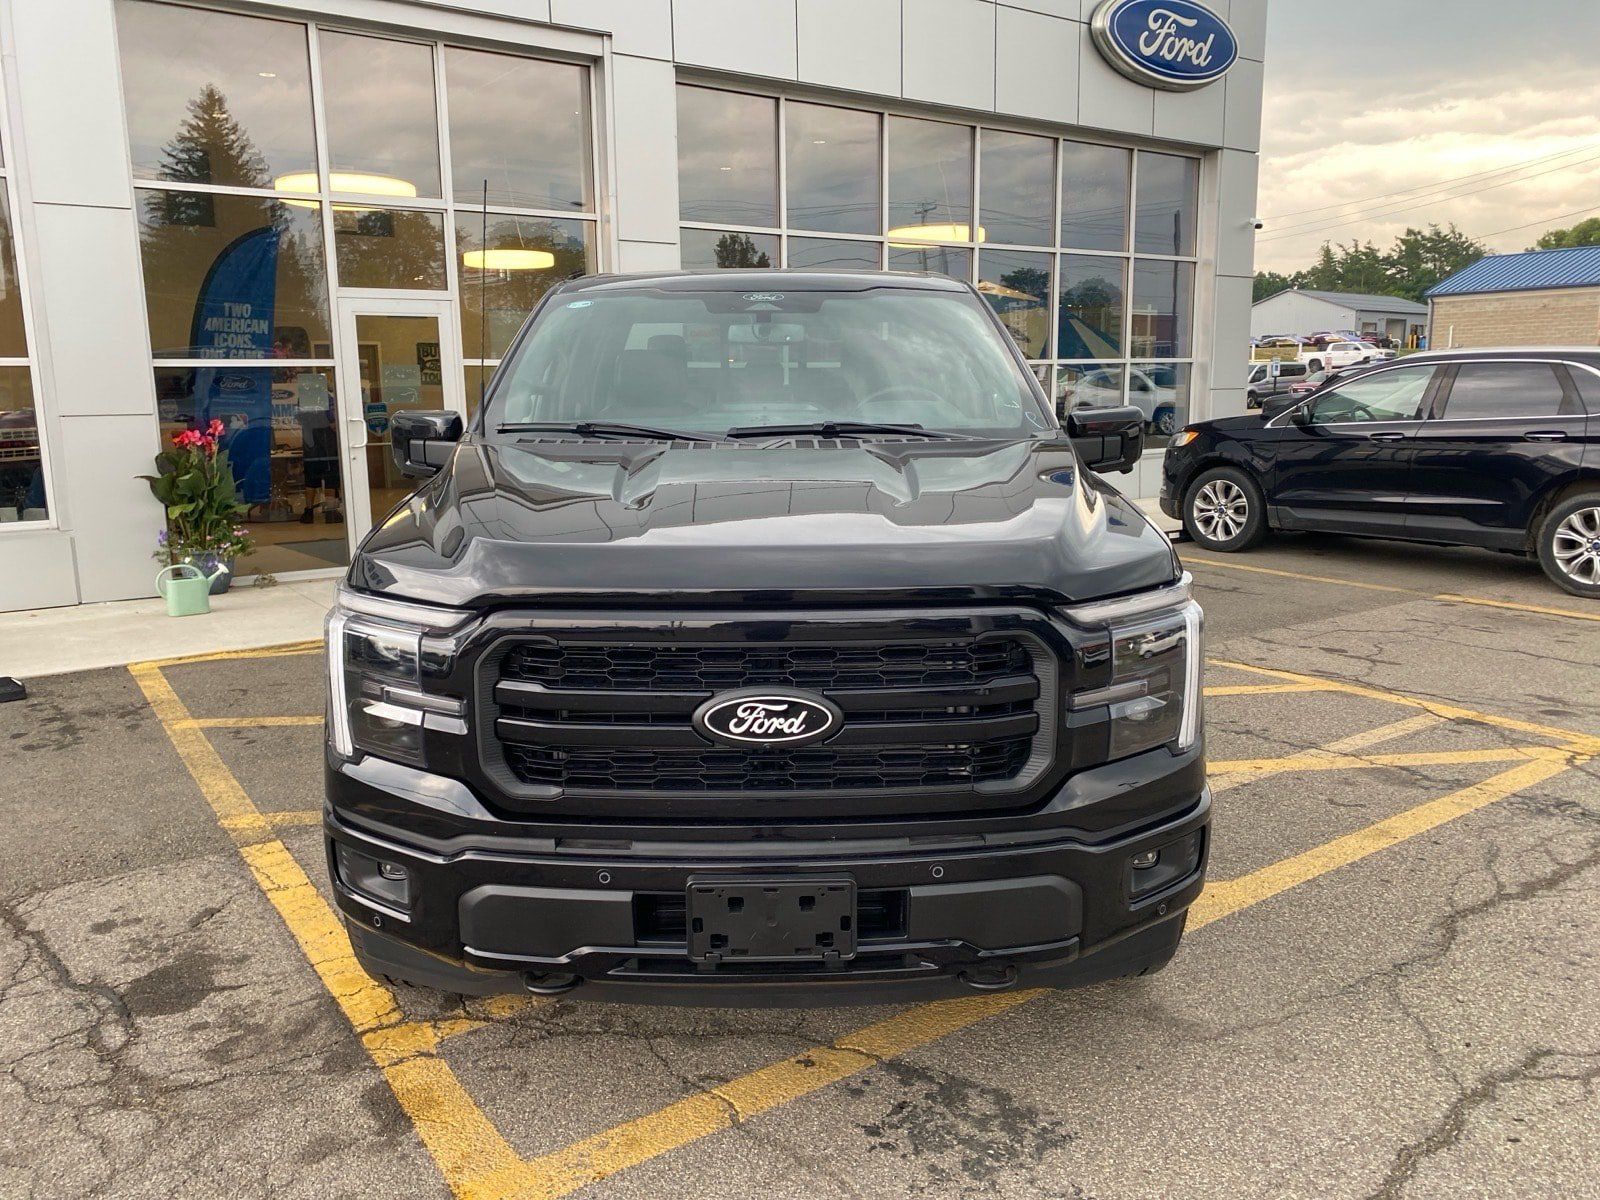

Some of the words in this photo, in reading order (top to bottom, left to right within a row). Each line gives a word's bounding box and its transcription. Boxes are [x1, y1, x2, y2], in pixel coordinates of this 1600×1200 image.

[1140, 9, 1214, 67] Ford
[223, 302, 252, 318] TWO
[204, 317, 269, 334] AMERICAN
[214, 333, 256, 349] ICONS.
[200, 348, 227, 359] ONE
[219, 376, 249, 389] Ford
[729, 702, 807, 734] Ford
